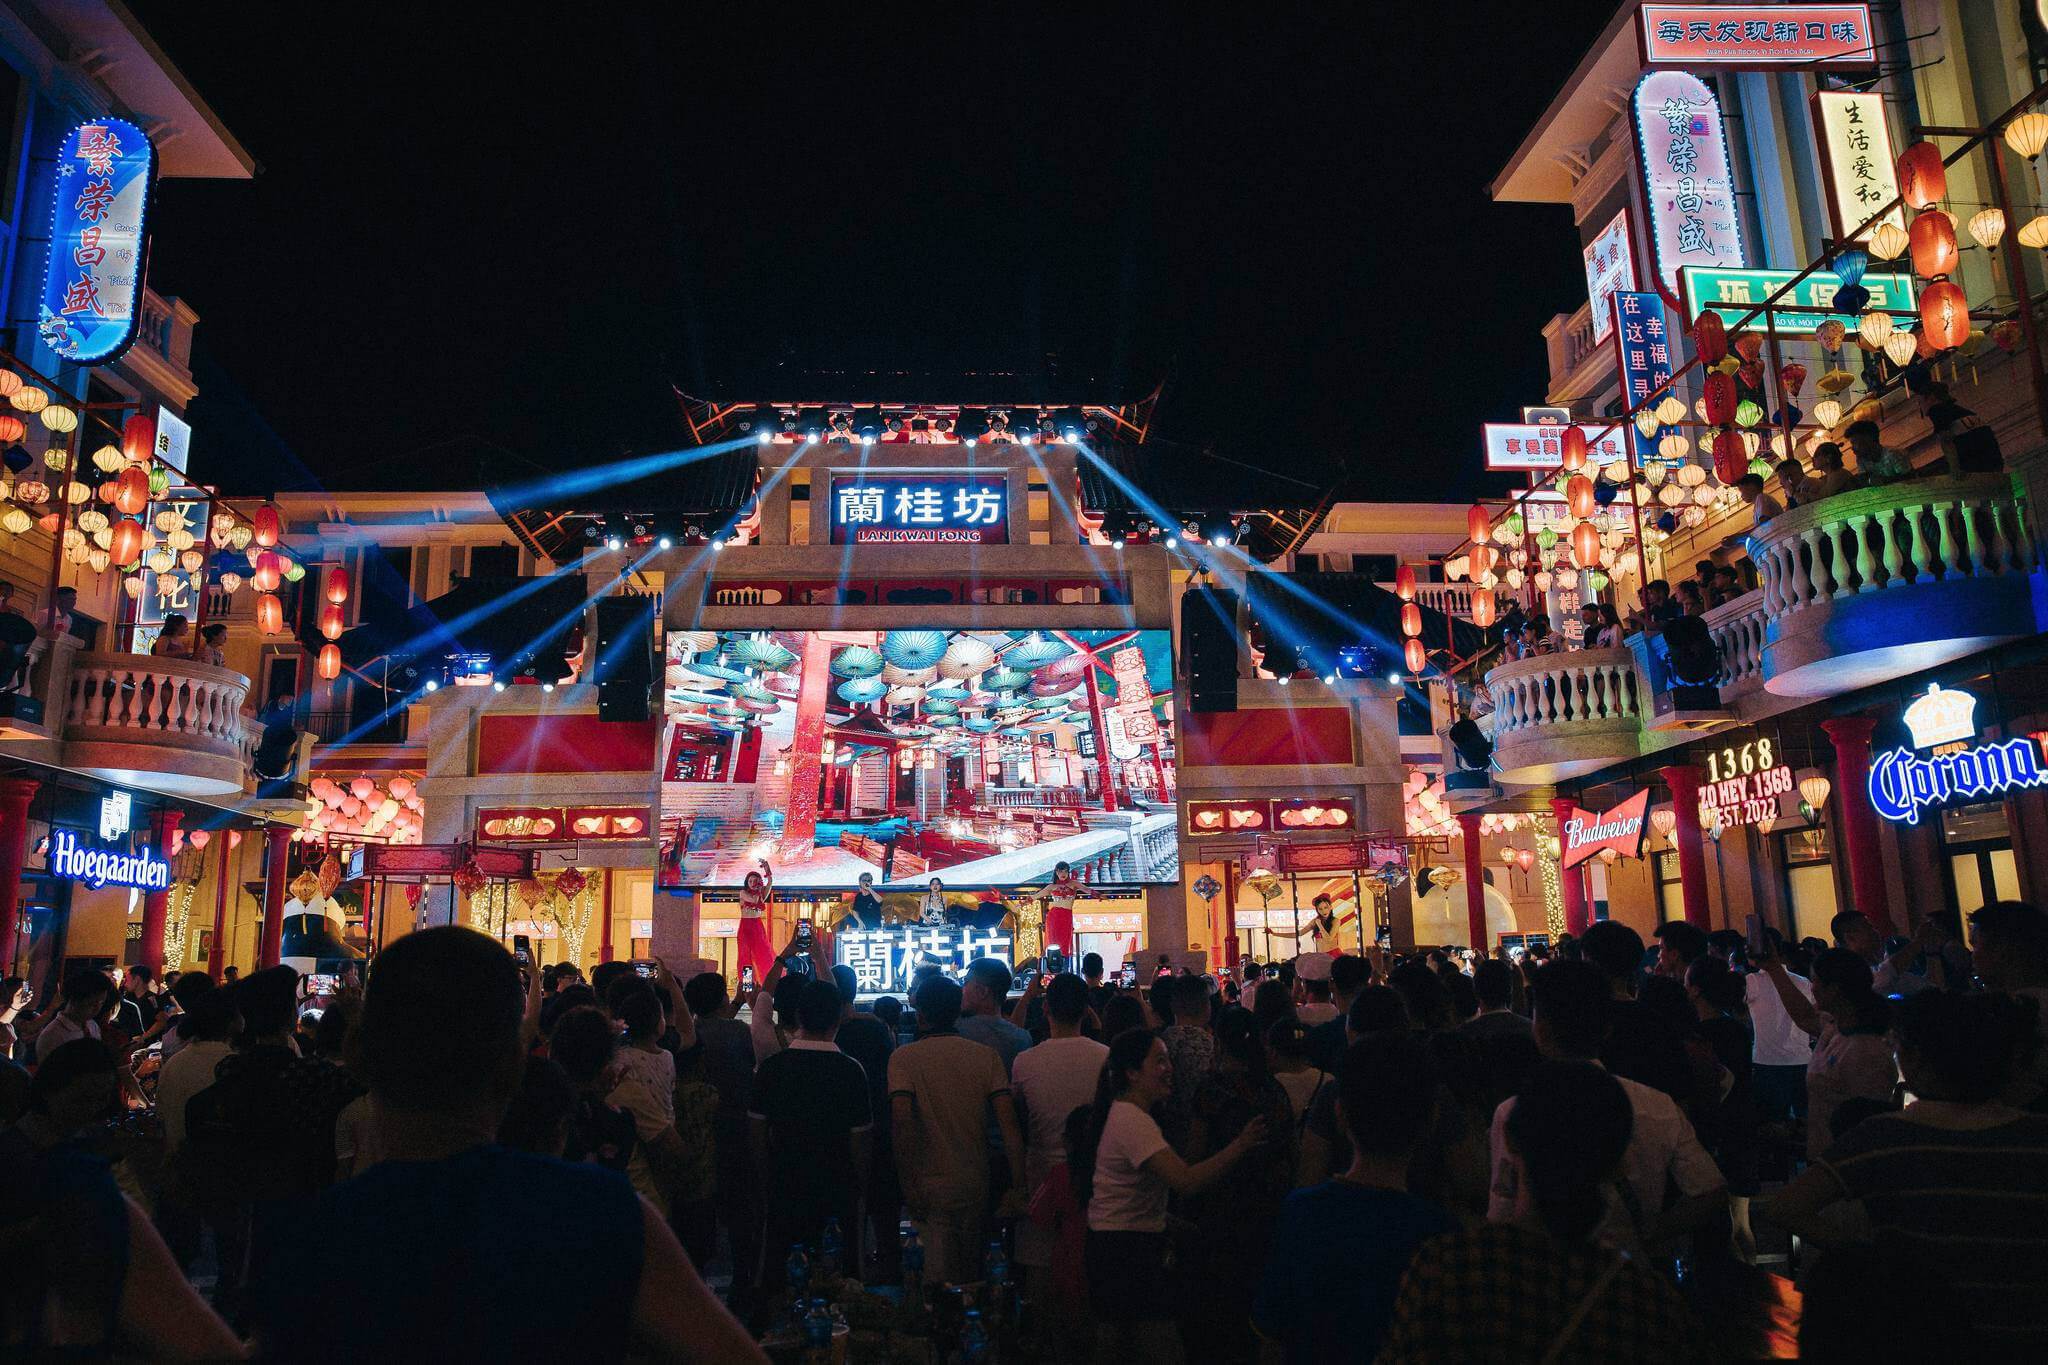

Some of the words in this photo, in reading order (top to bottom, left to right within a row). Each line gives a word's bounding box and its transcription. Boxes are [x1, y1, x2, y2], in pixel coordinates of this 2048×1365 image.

[1657, 19, 1859, 43] 每天发现新口味
[1659, 98, 1715, 256] 繁荣昌盛
[61, 133, 122, 317] 繁荣昌盛
[1622, 293, 1653, 410] 在这里寻
[1506, 438, 1616, 456] 享受美肴
[837, 487, 1001, 524] 蘭桂坊
[857, 530, 892, 542] LAN
[893, 530, 934, 542] KWAI
[937, 530, 981, 542] FONG
[1707, 738, 1773, 783] 1368
[1698, 785, 1717, 809] ZO
[1869, 738, 2041, 825] Corona
[1744, 798, 1777, 823] 2022
[1564, 812, 1643, 849] Budweiser
[55, 832, 167, 887] Hoegaarden
